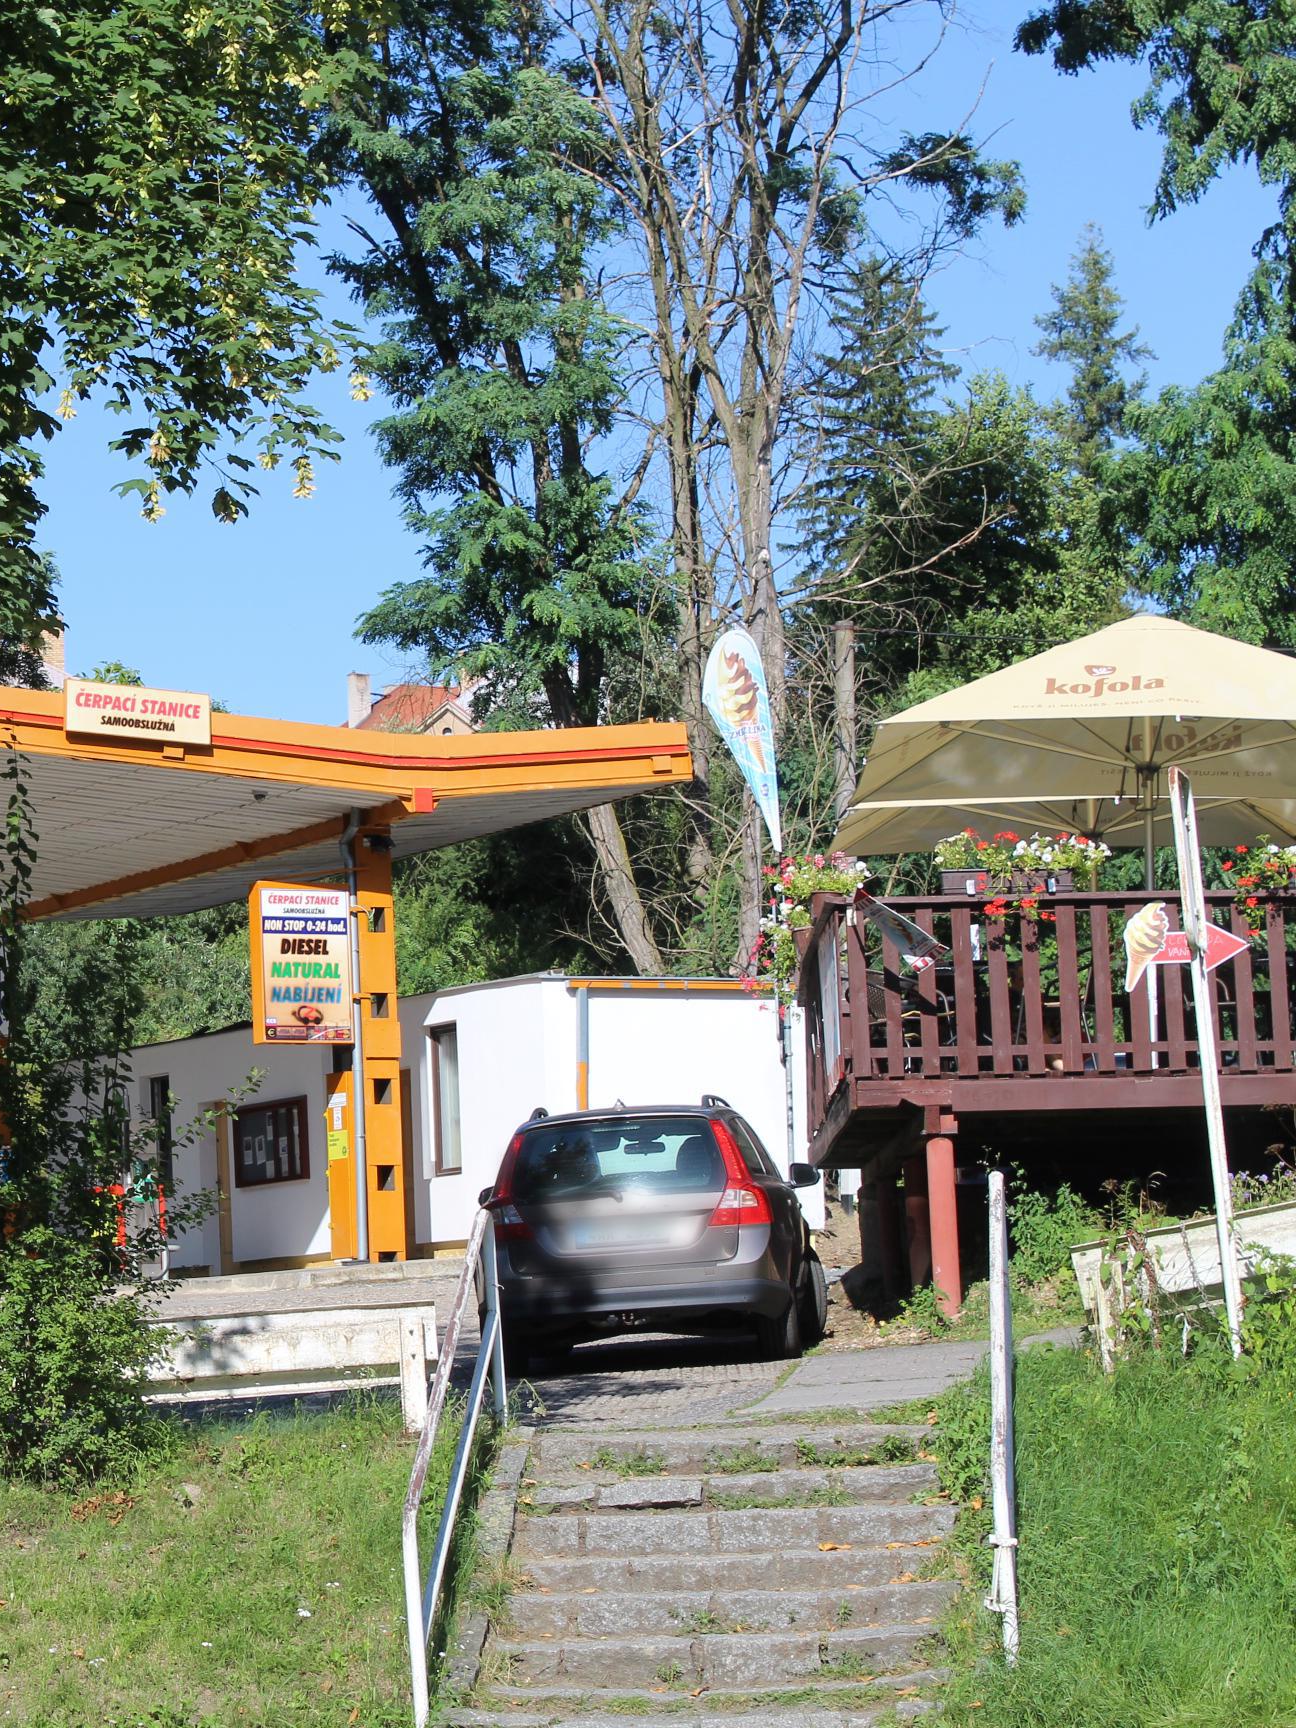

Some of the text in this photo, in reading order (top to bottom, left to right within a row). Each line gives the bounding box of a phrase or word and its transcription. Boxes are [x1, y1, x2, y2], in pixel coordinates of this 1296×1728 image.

[1044, 675, 1165, 698] kofola
[75, 687, 201, 720] ČERPACÍ STANICE
[100, 714, 176, 733] SAMOOBSLUŽNÁ
[268, 892, 340, 906] ČERPACÍ STANICE
[264, 920, 346, 932] NON STOP 0-24 hod.
[280, 938, 329, 956] DIESEL
[271, 961, 341, 980] NATURAL
[271, 981, 342, 1004] NABÍJENÍ
